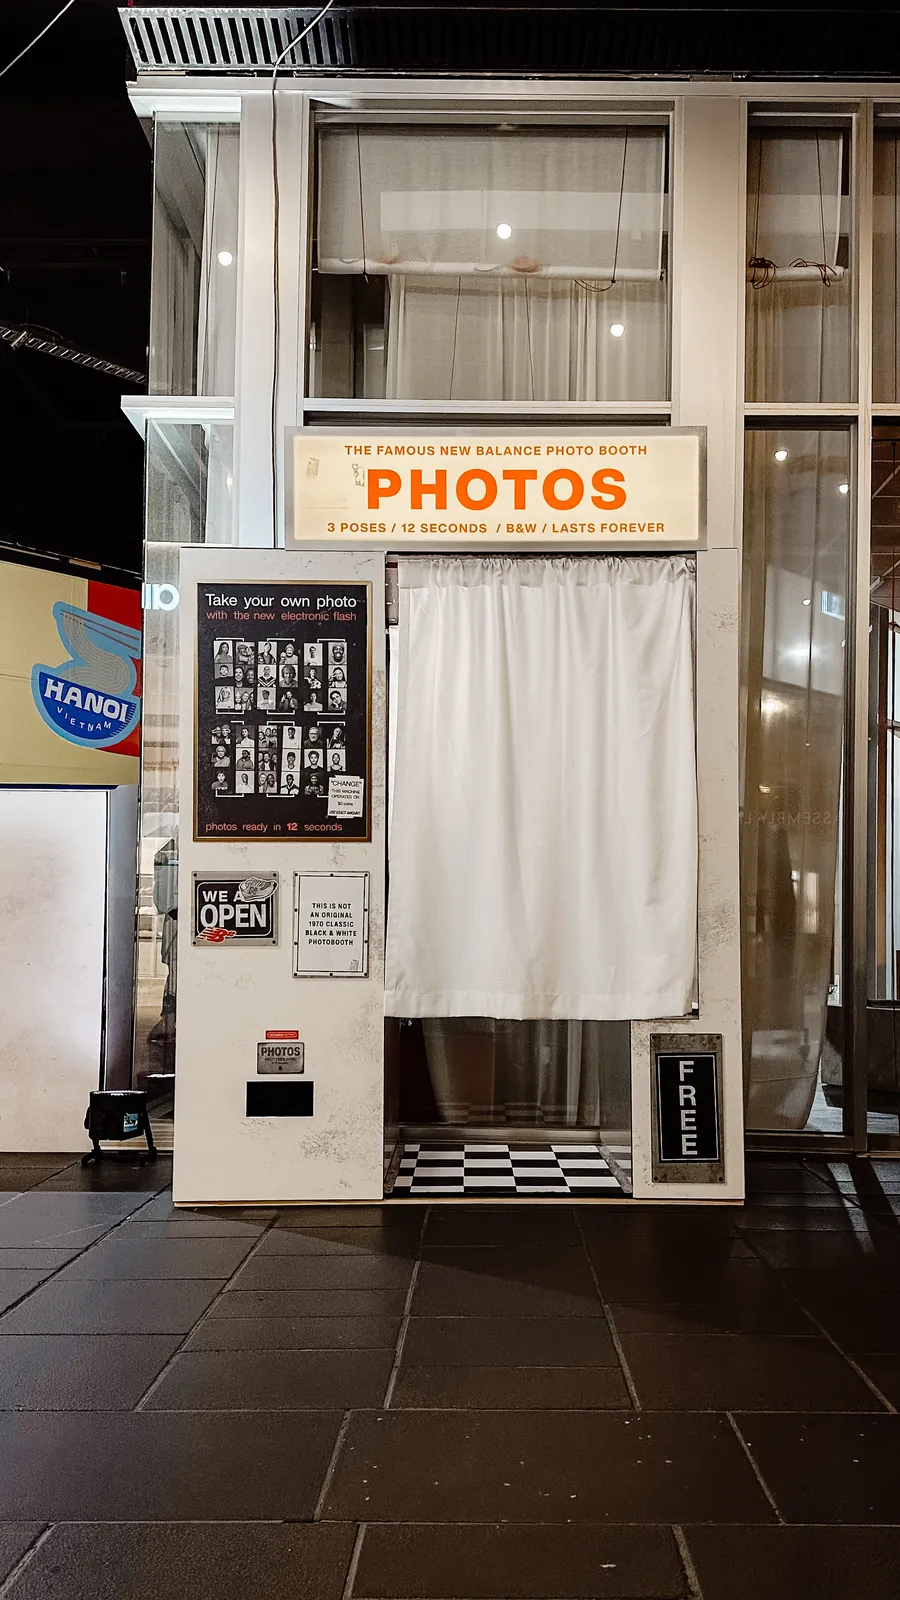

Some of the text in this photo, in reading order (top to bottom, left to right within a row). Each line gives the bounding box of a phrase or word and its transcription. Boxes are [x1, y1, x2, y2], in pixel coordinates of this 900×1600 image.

[344, 445, 647, 456] THE FAMOUS NEW BALANCE PHOTO BOOTH
[367, 467, 627, 511] PHOTOS
[327, 522, 665, 533] 3 POSES / 12 SECONDS / B&W / LASTS FOREVER
[205, 593, 357, 610] Take your own photo
[206, 611, 357, 621] with the new electronic flash
[44, 677, 129, 723] HANOI
[57, 706, 112, 732] VIETNAM
[205, 822, 343, 833] photos ready in 12 seconds
[202, 890, 228, 903] WE
[200, 903, 267, 928] OPEN
[260, 1046, 301, 1057] PHOTOS
[678, 1060, 698, 1156] FREE
